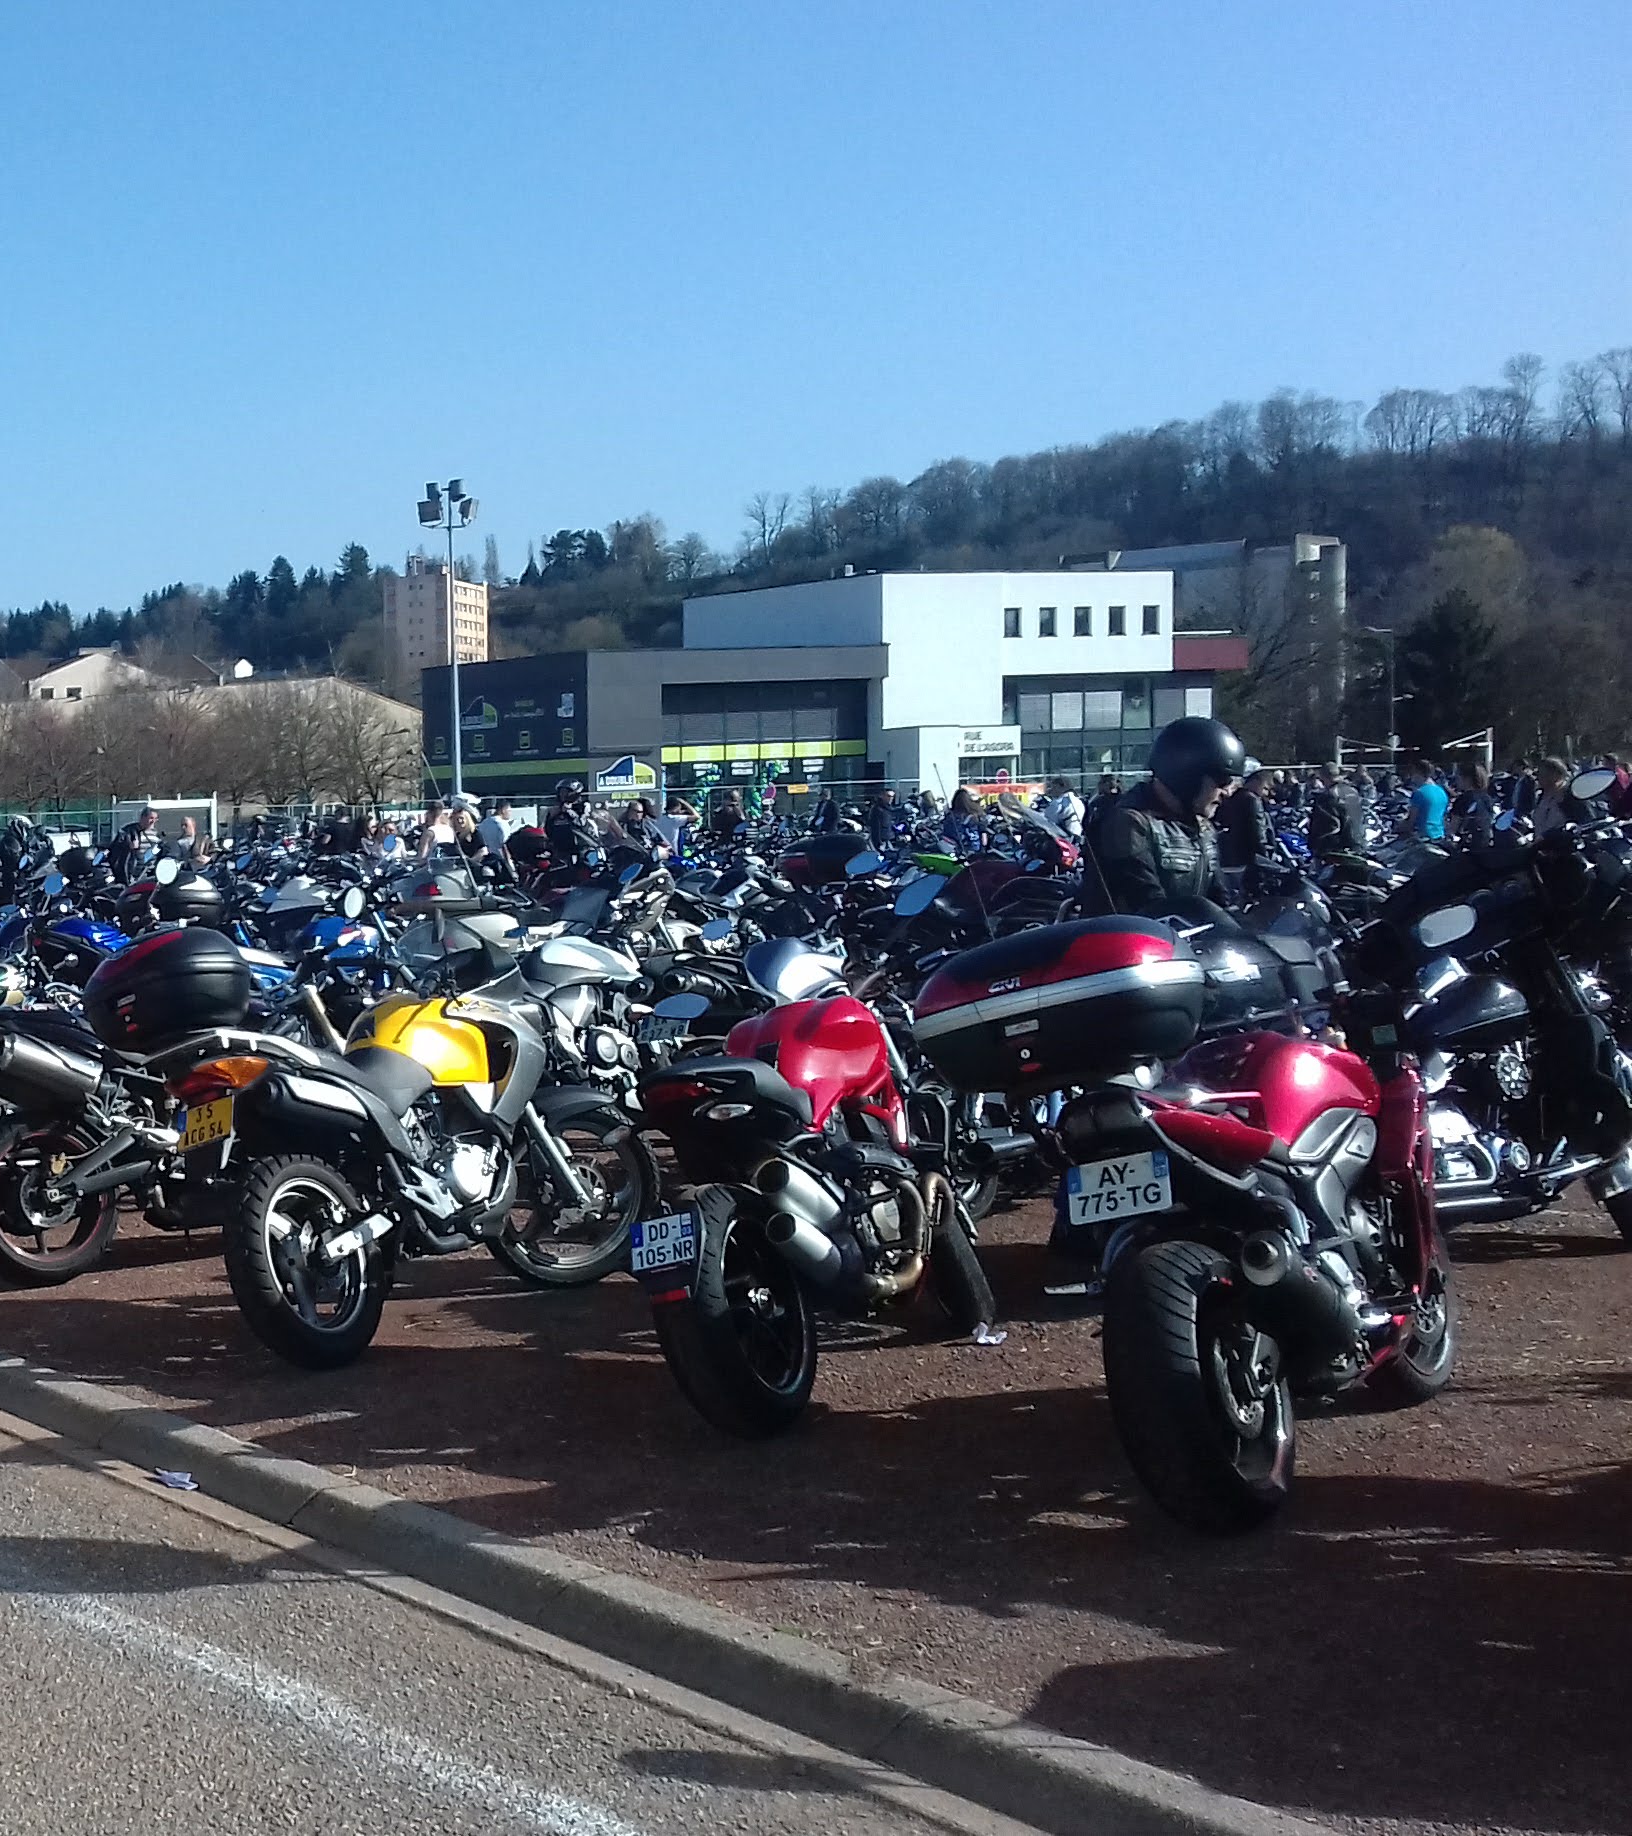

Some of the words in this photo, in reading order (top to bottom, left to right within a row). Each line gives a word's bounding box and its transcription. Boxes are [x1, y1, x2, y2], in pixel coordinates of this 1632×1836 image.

[964, 731, 982, 741] RUE
[1077, 1182, 1162, 1217] 775-TG
[637, 1239, 693, 1268] 105-NR
